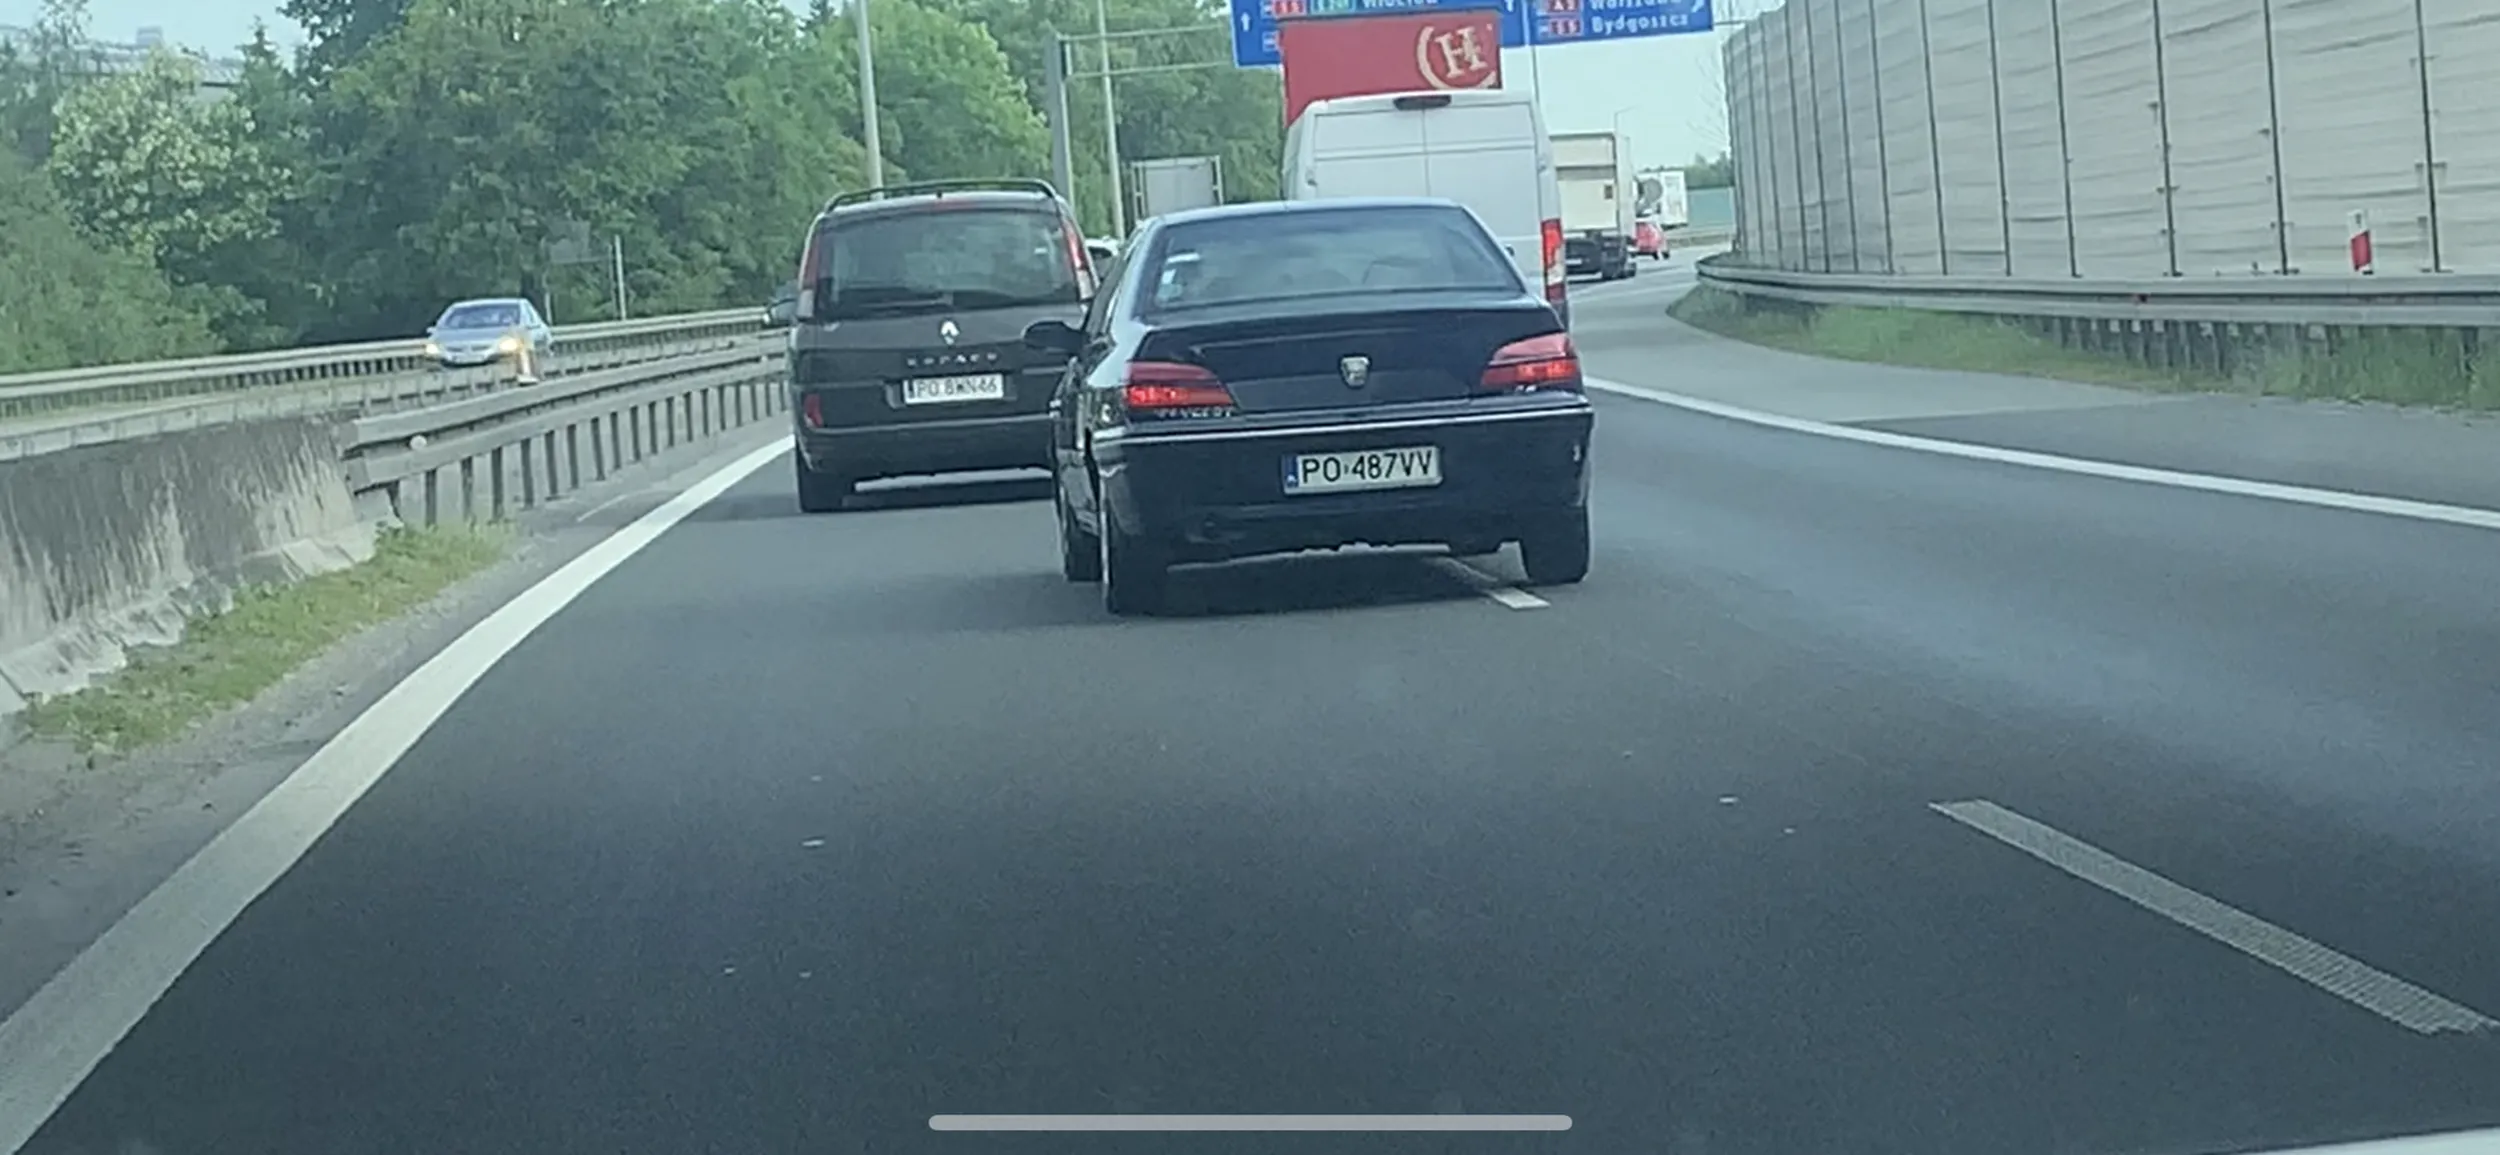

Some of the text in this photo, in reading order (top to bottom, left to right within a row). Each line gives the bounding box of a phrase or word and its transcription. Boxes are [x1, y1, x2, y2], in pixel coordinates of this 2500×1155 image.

[1590, 0, 1684, 11] Warsza
[1590, 13, 1690, 36] Bydgoszcz
[1302, 450, 1432, 484] PO 487VV
